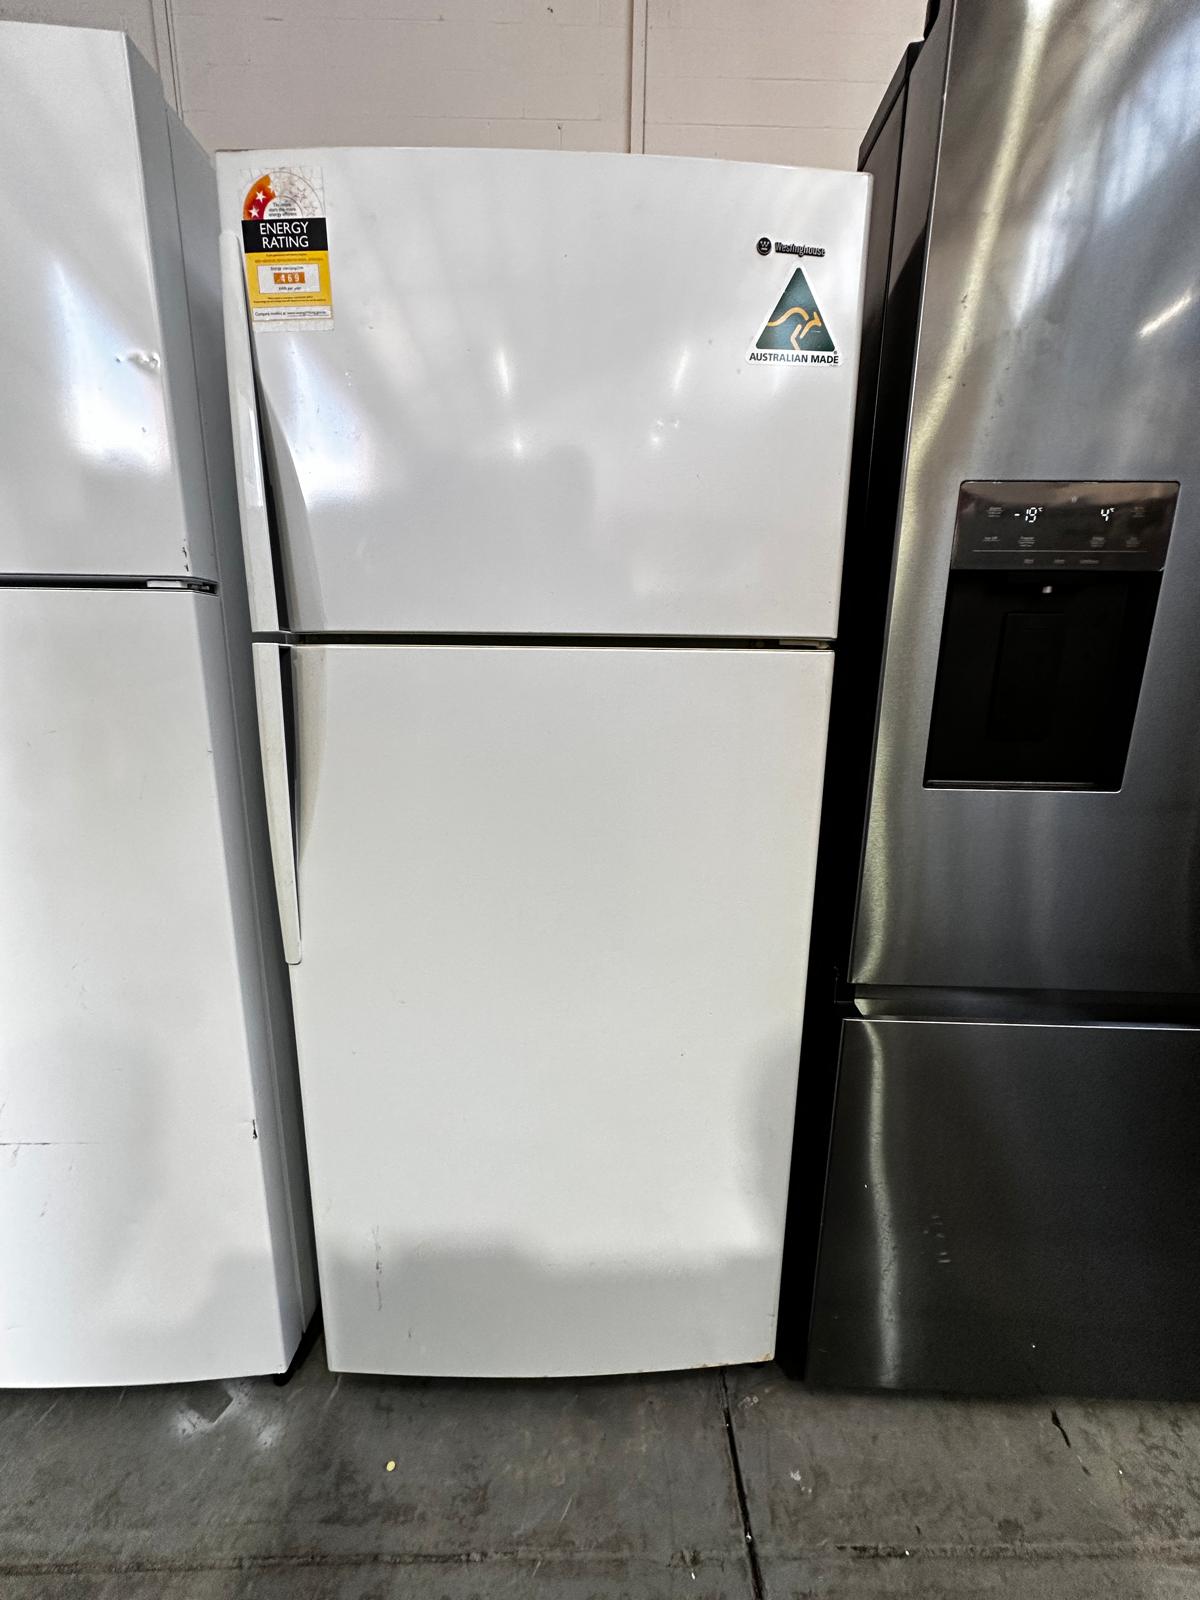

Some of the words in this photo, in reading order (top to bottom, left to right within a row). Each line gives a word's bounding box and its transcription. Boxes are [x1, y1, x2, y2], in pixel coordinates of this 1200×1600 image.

[259, 221, 309, 235] ENERGY
[262, 235, 309, 249] RATING
[774, 242, 826, 257] Westinghouse
[279, 273, 300, 283] 469
[749, 353, 808, 363] AUSTRALIAN
[810, 355, 839, 364] MADE
